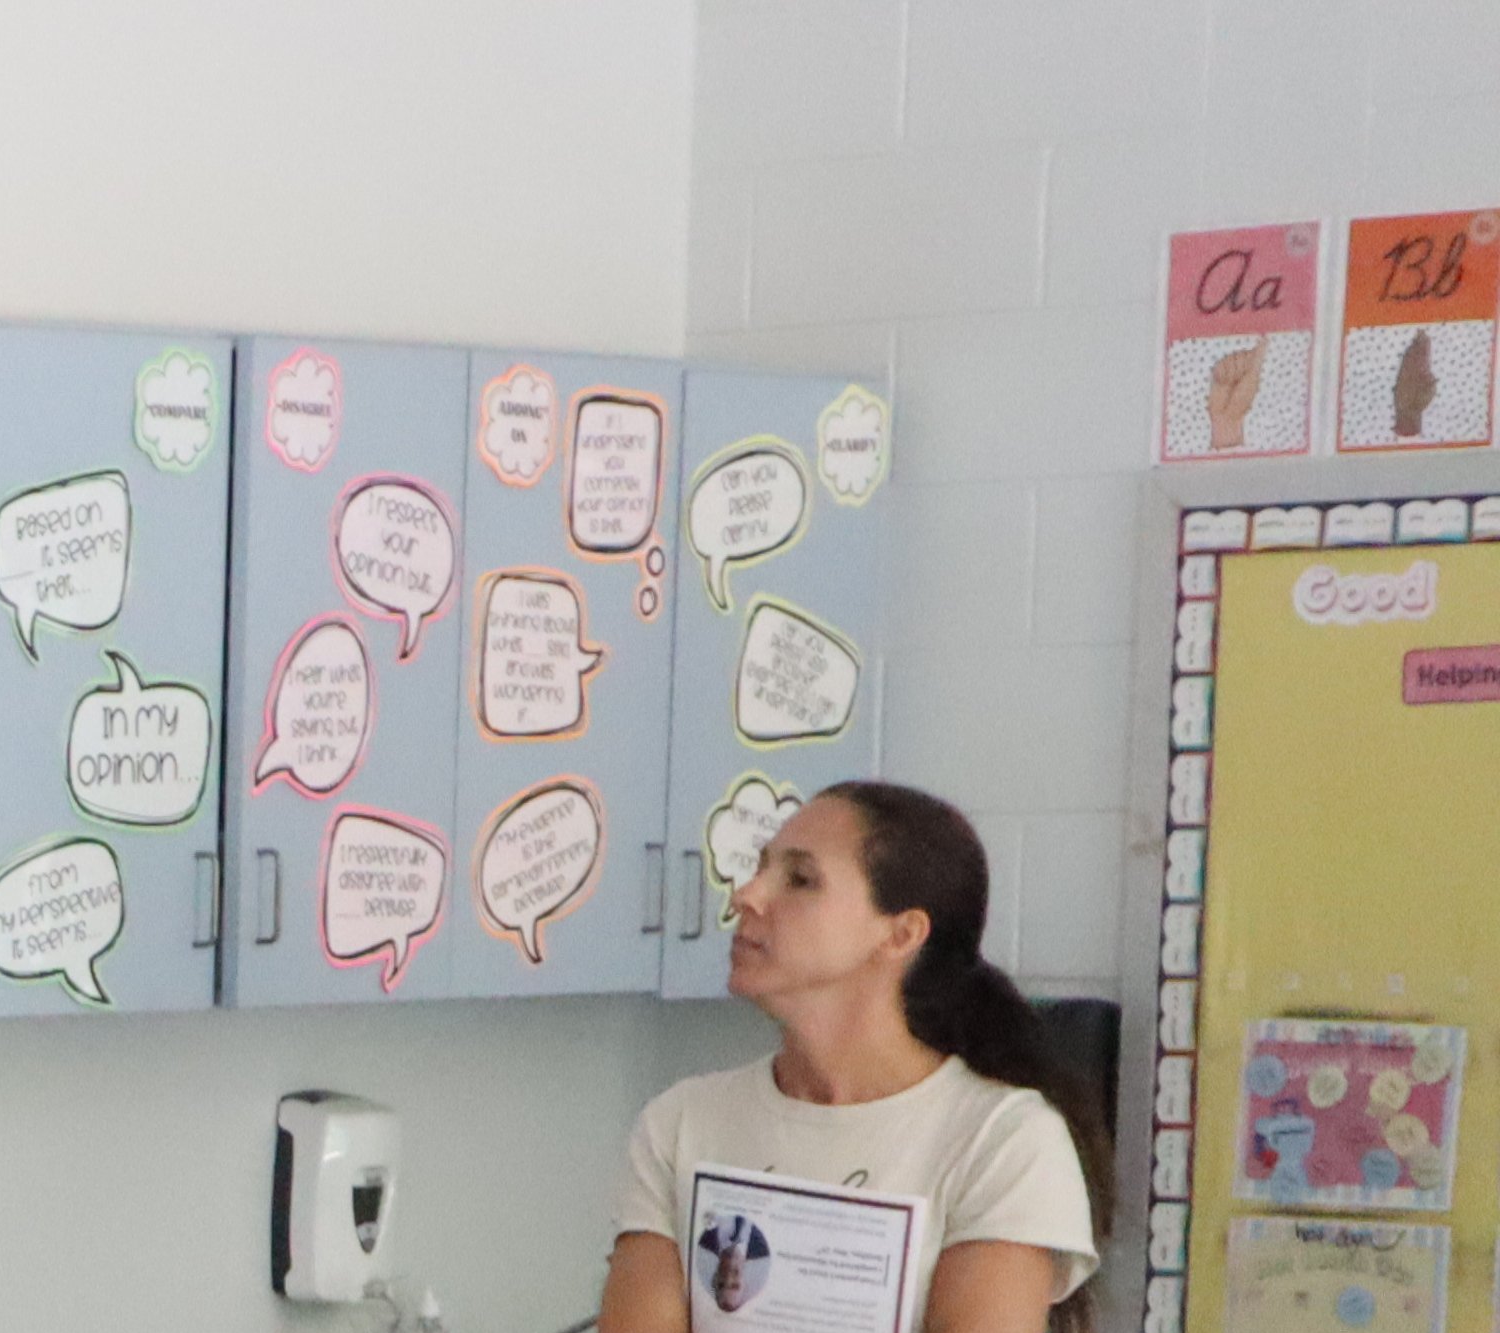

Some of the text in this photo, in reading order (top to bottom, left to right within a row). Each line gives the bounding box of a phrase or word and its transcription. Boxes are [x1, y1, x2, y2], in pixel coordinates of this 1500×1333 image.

[1195, 249, 1283, 314] Aa
[1378, 232, 1468, 304] Bb
[1301, 564, 1429, 614] Good
